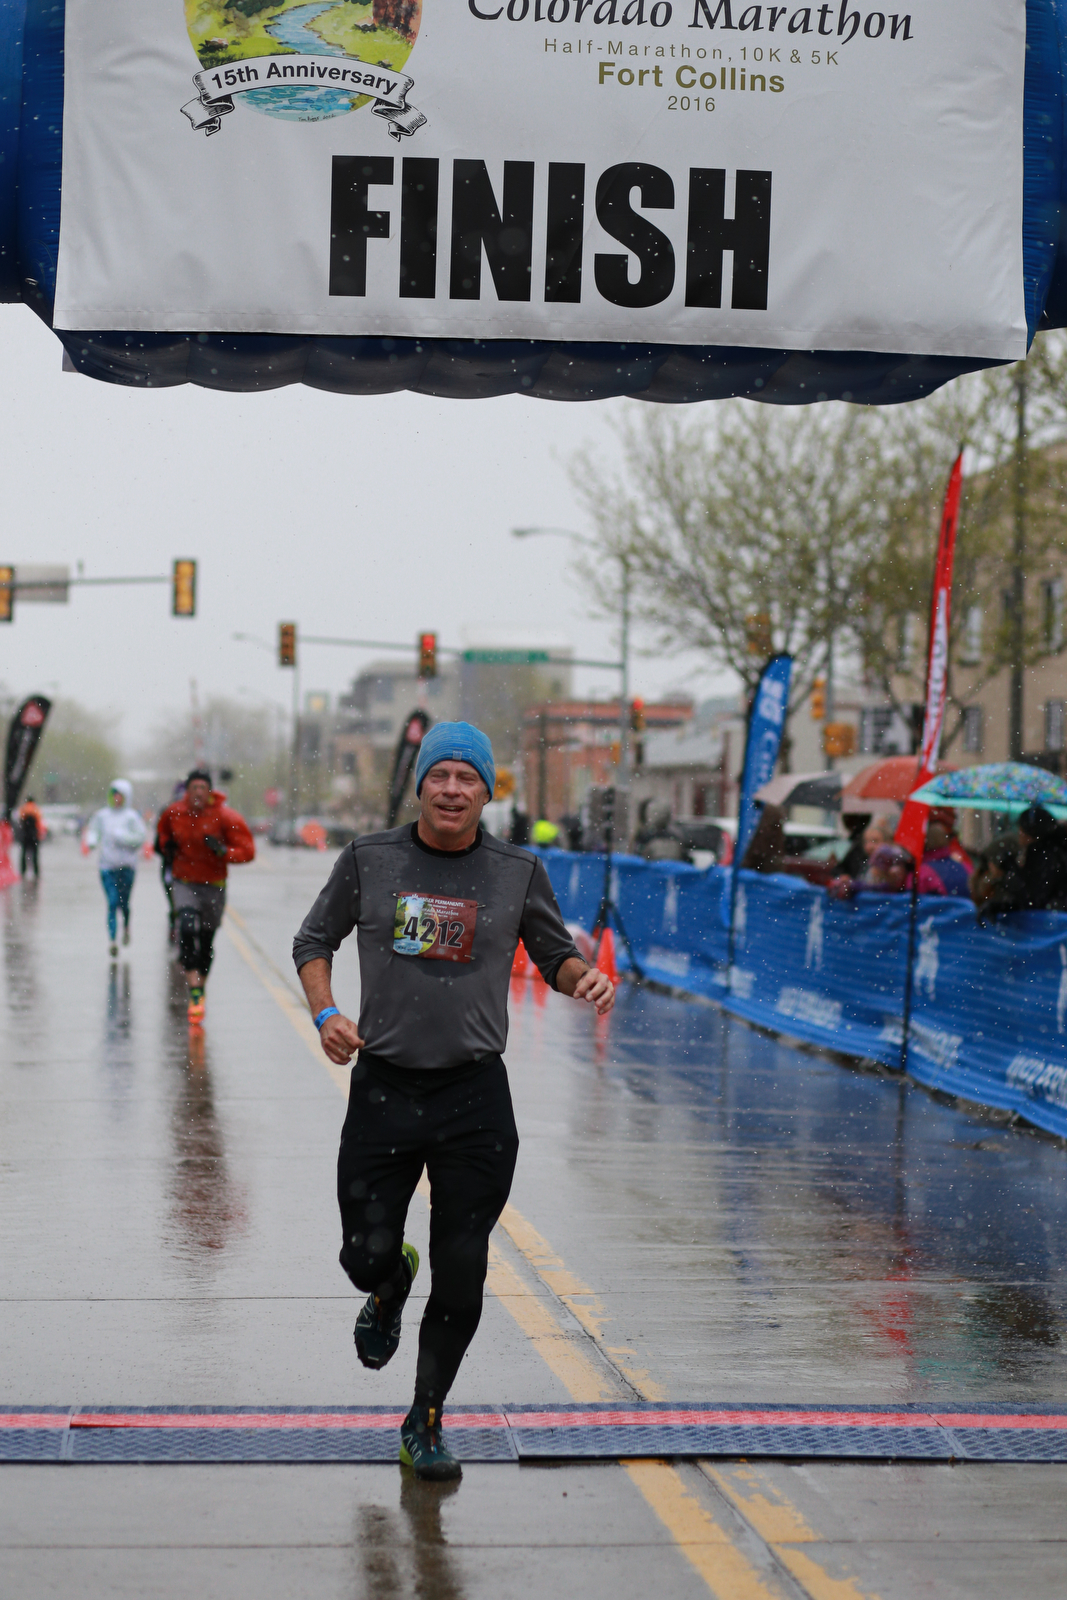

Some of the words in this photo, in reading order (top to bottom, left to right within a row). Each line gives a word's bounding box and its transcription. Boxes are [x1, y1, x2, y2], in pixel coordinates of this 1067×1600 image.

[467, 0, 672, 28] Colorado
[687, 0, 914, 45] Marathon
[740, 46, 782, 63] 10K
[789, 49, 802, 64] &
[810, 50, 839, 66] 5K
[211, 65, 259, 89] 15th
[266, 62, 398, 96] Anniversary
[598, 61, 663, 88] Fort
[675, 65, 785, 93] Collins
[668, 95, 716, 112] 2016
[329, 154, 773, 311] FINISH
[403, 916, 465, 948] 4212
